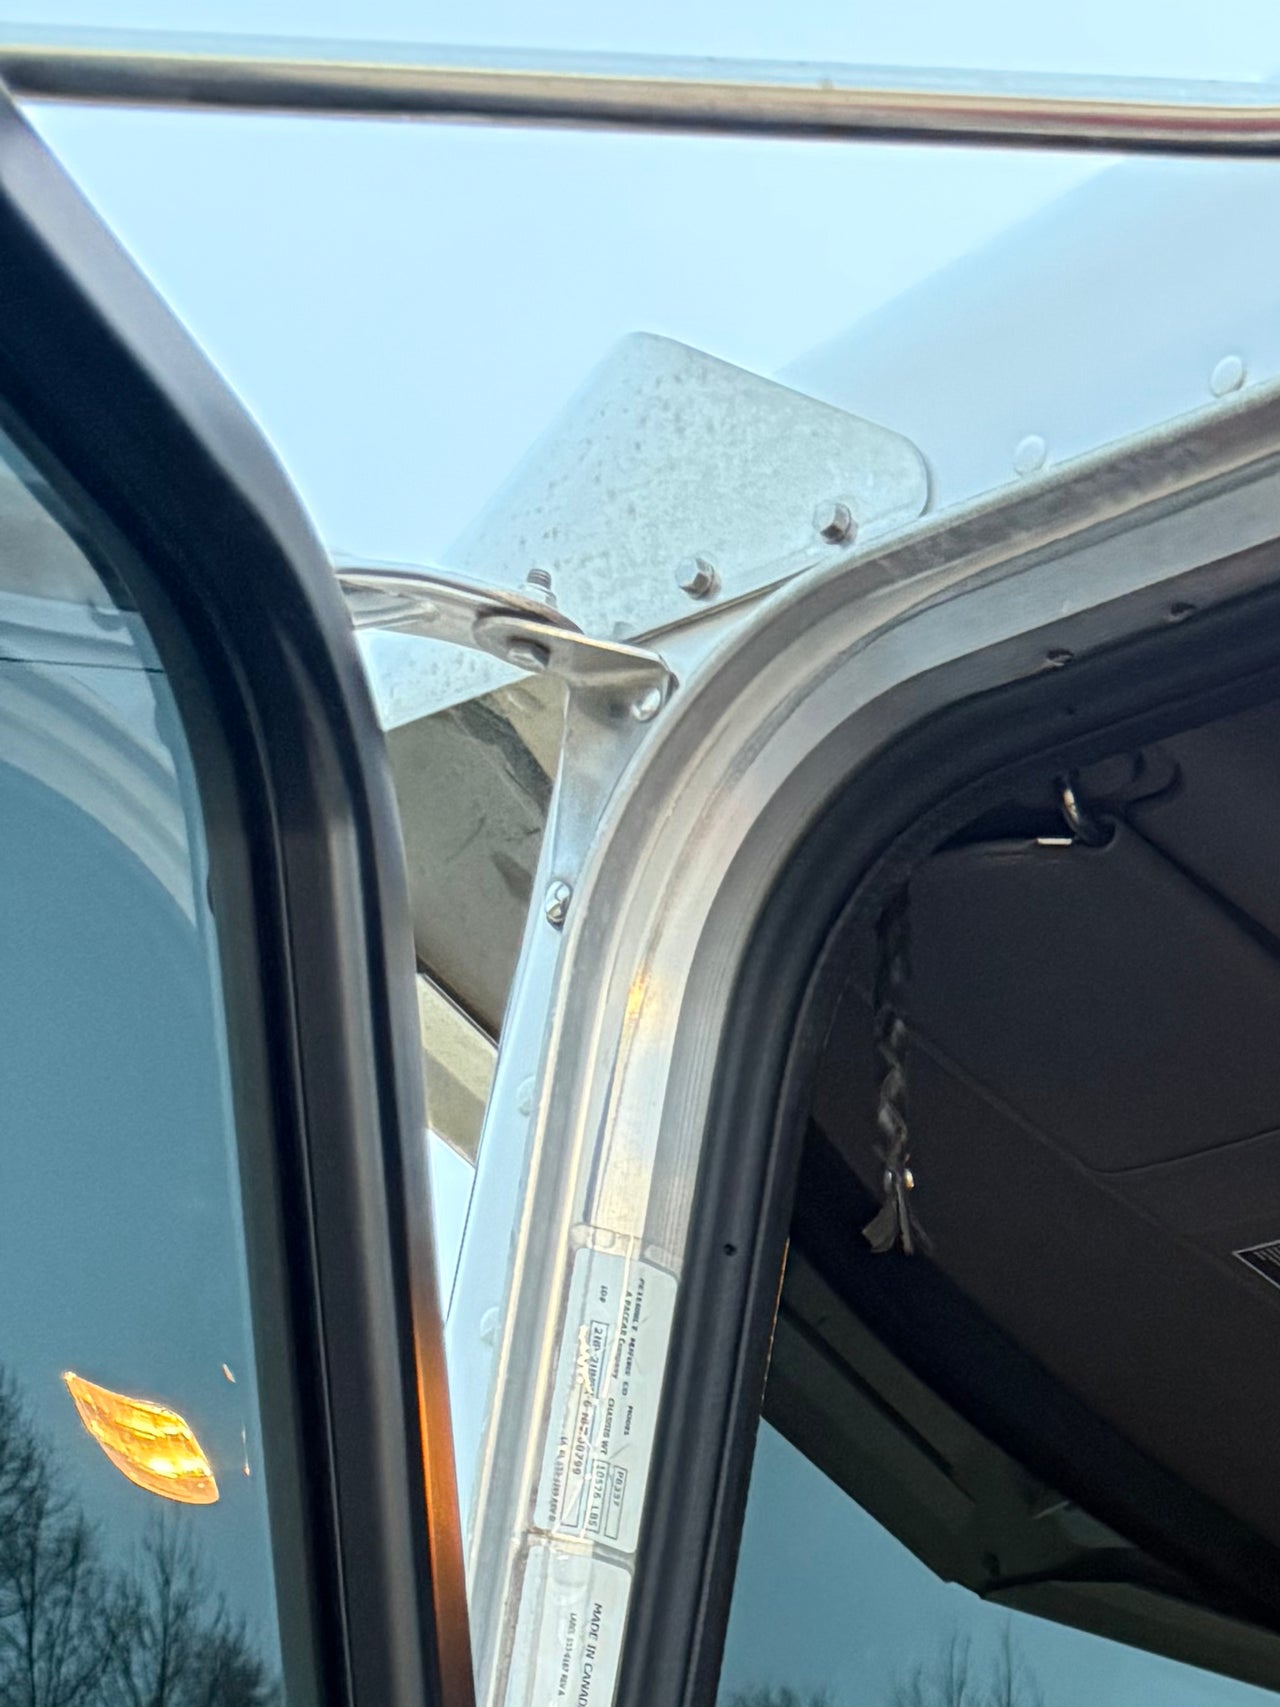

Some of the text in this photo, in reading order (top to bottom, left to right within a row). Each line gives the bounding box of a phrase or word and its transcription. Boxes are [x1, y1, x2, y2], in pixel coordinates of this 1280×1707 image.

[618, 1299, 630, 1336] PACCAR
[610, 1337, 625, 1379] Company
[600, 1397, 615, 1455] CHASSIS WT
[588, 1505, 599, 1526] LBS
[566, 1612, 577, 1635] LABEL
[587, 1602, 603, 1640] MADE
[584, 1644, 596, 1659] IN
[558, 1673, 567, 1689] REV
